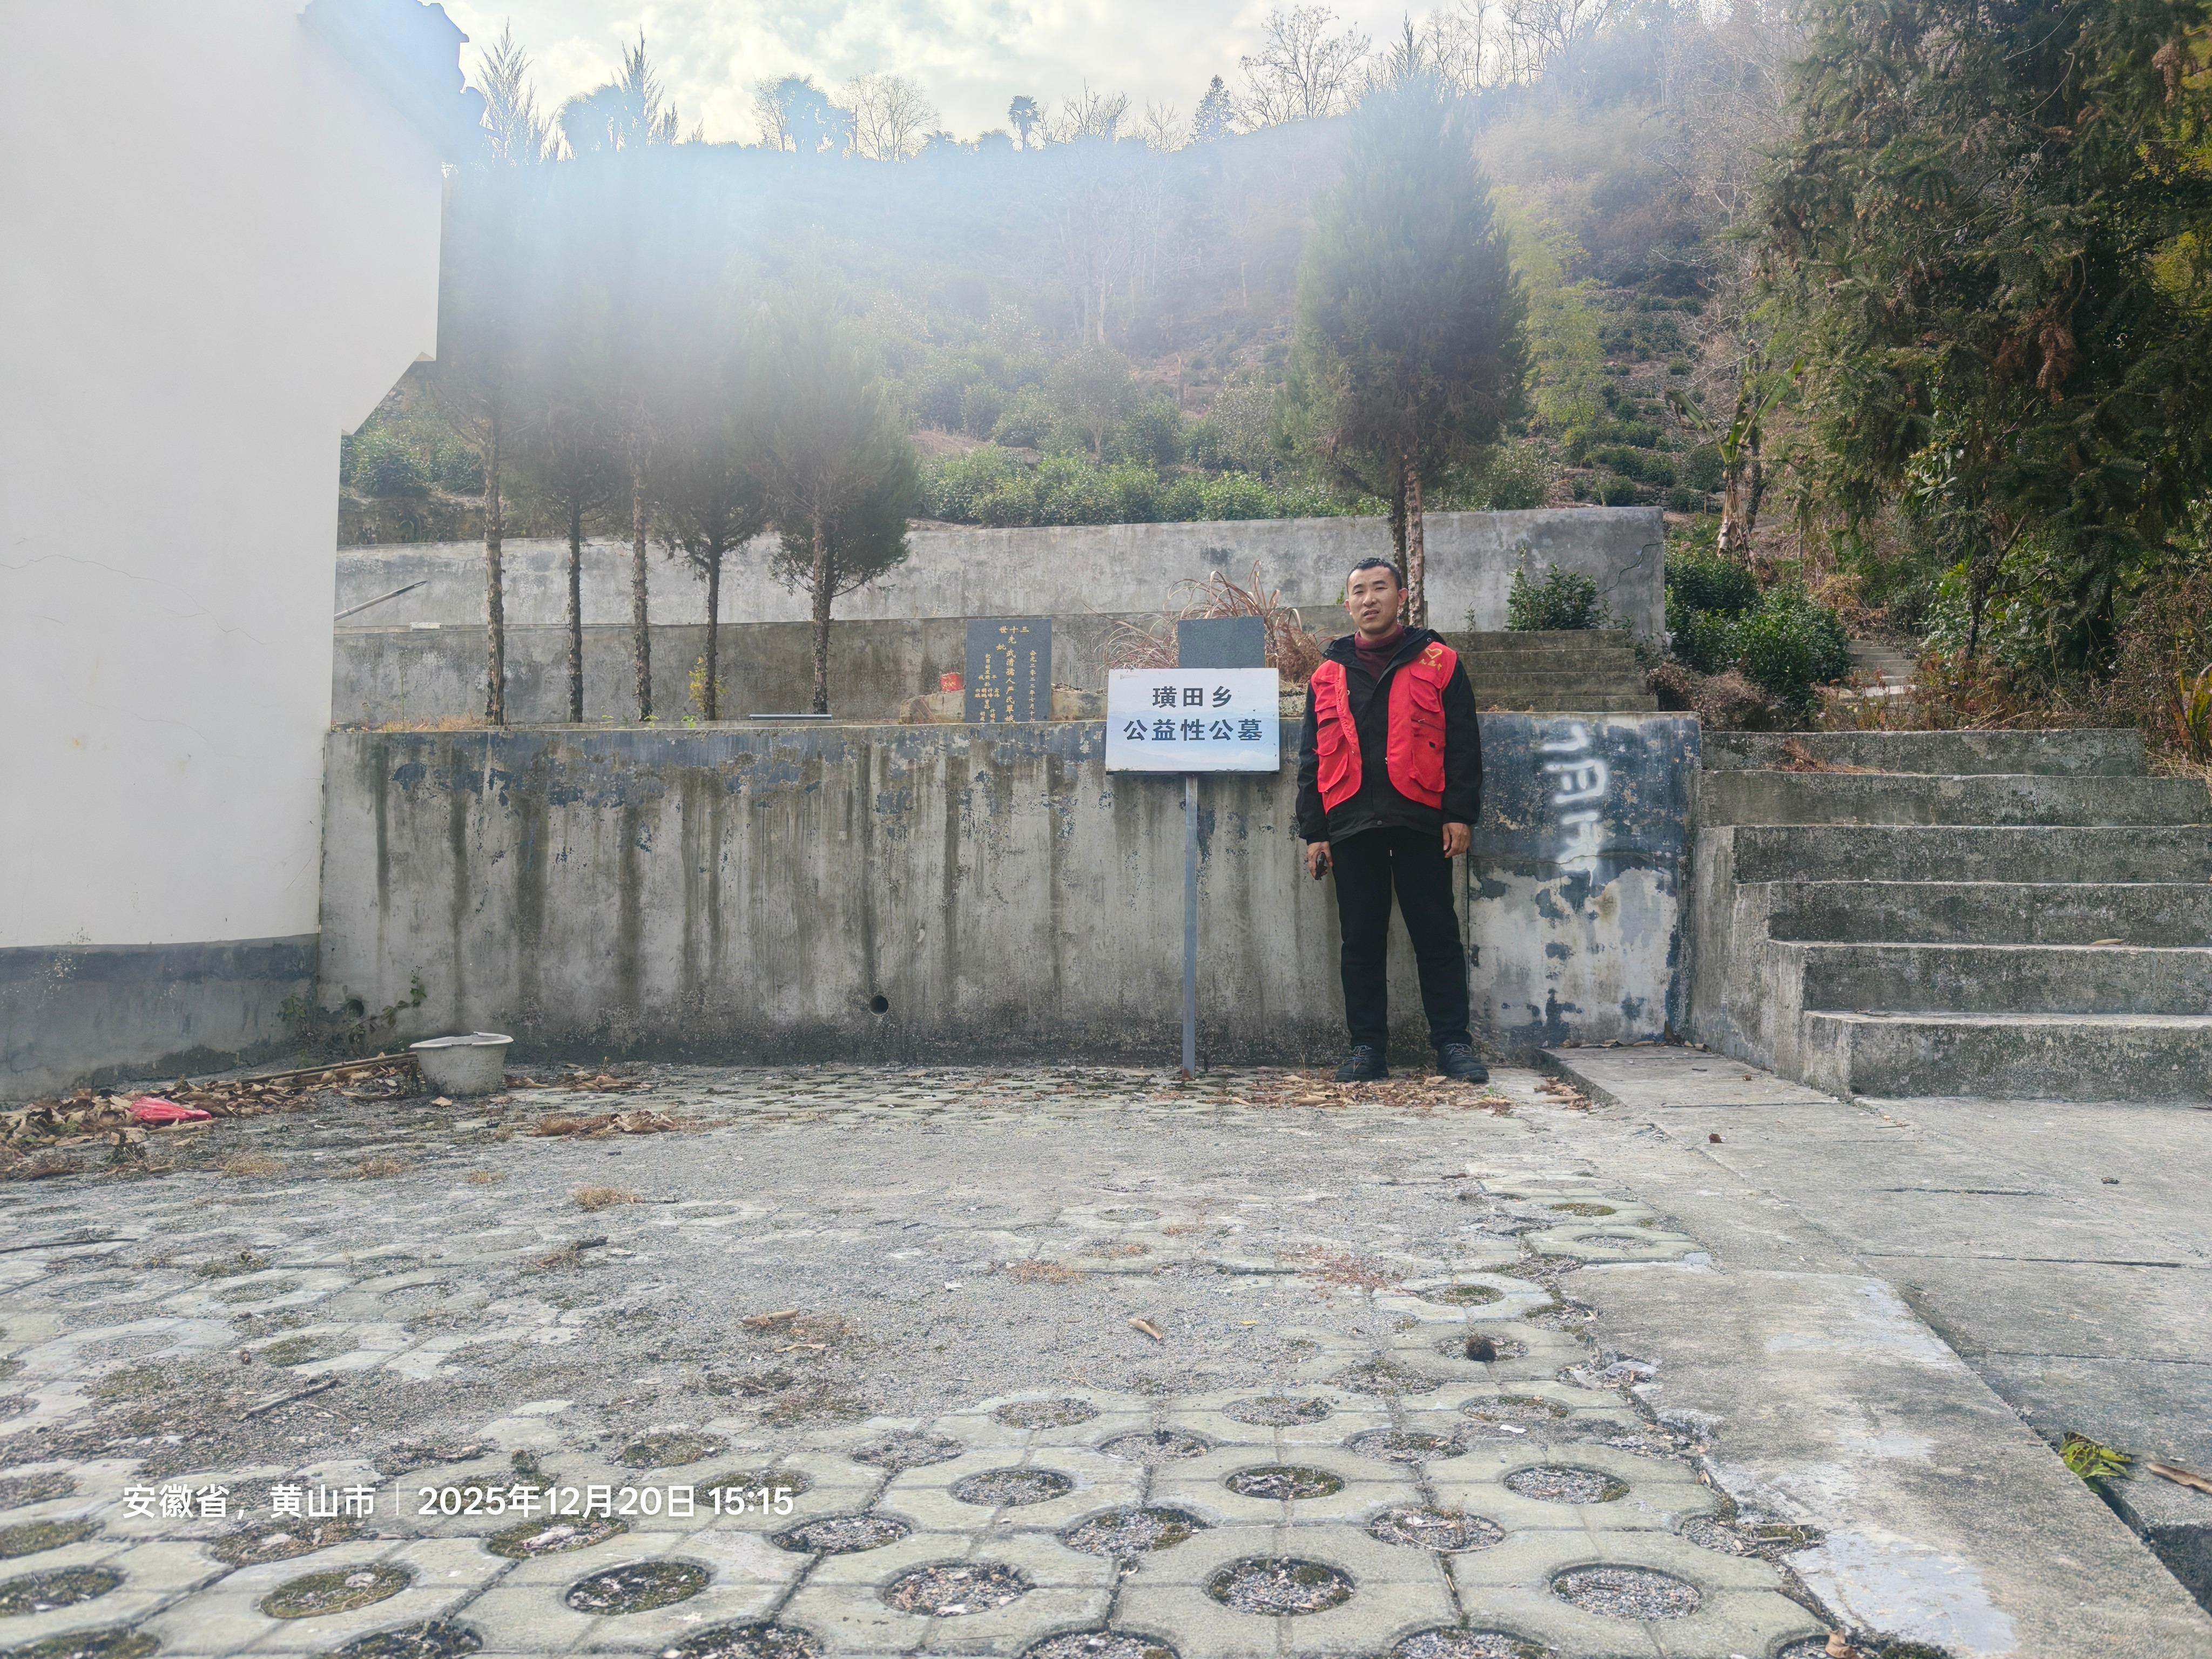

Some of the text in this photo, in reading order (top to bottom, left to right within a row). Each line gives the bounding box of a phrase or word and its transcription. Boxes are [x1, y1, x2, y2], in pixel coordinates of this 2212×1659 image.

[1152, 686, 1232, 709] 璜田乡
[1123, 719, 1263, 741] 公益性公墓
